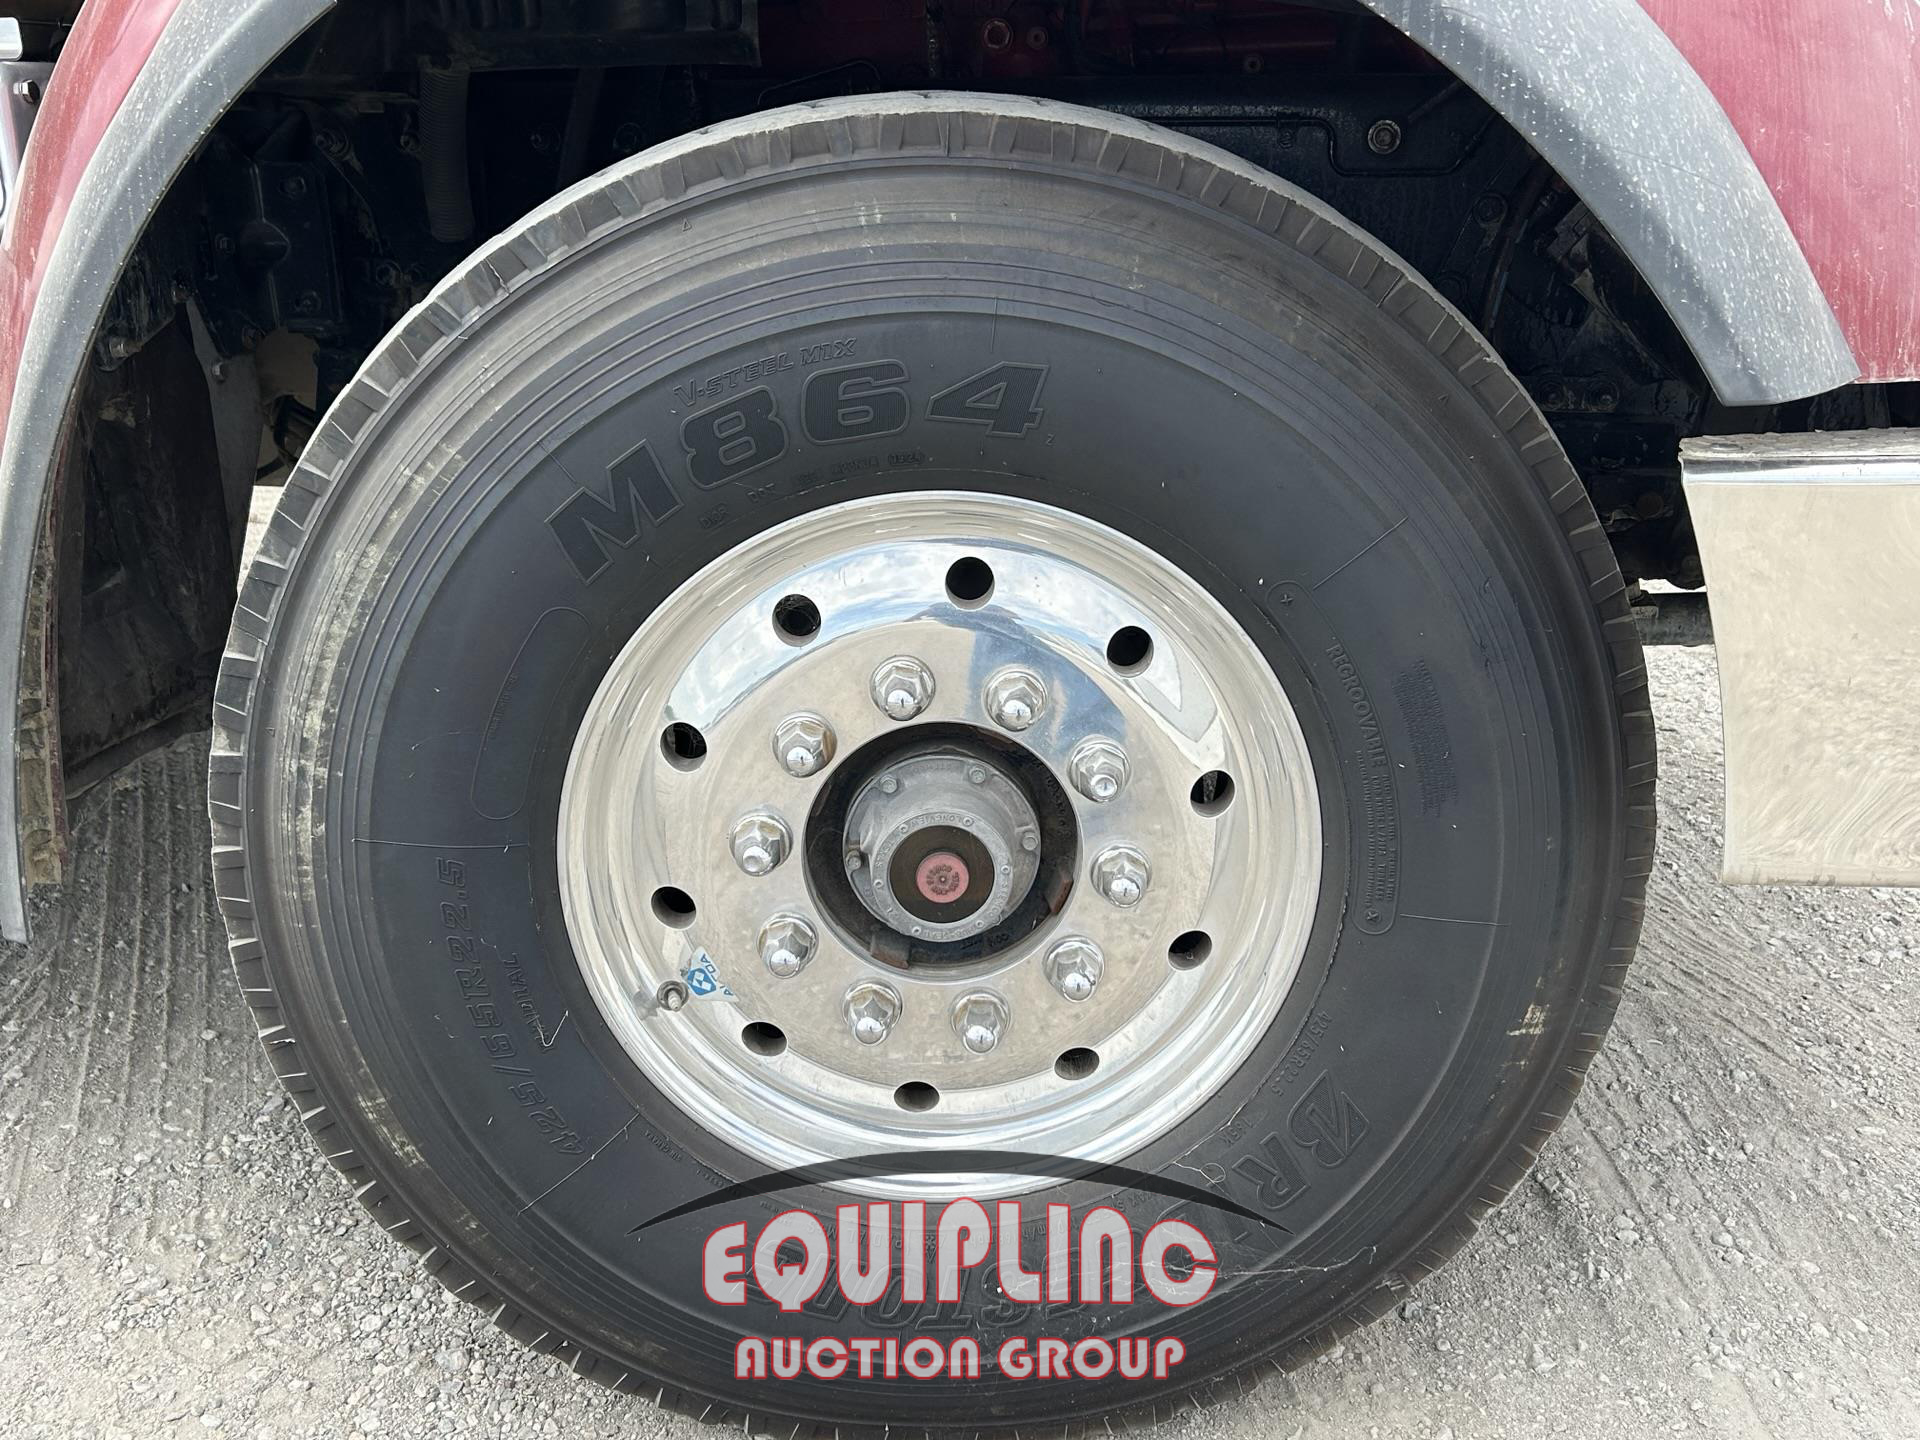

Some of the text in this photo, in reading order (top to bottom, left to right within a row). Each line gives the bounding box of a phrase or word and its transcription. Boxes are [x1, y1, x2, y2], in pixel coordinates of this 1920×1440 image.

[799, 337, 857, 366] MIX
[544, 359, 1050, 585] M864
[1325, 642, 1390, 768] REGROOVABLE
[436, 856, 586, 1157] 425/65R22.5
[1270, 1009, 1333, 1098] 425/65R22.5
